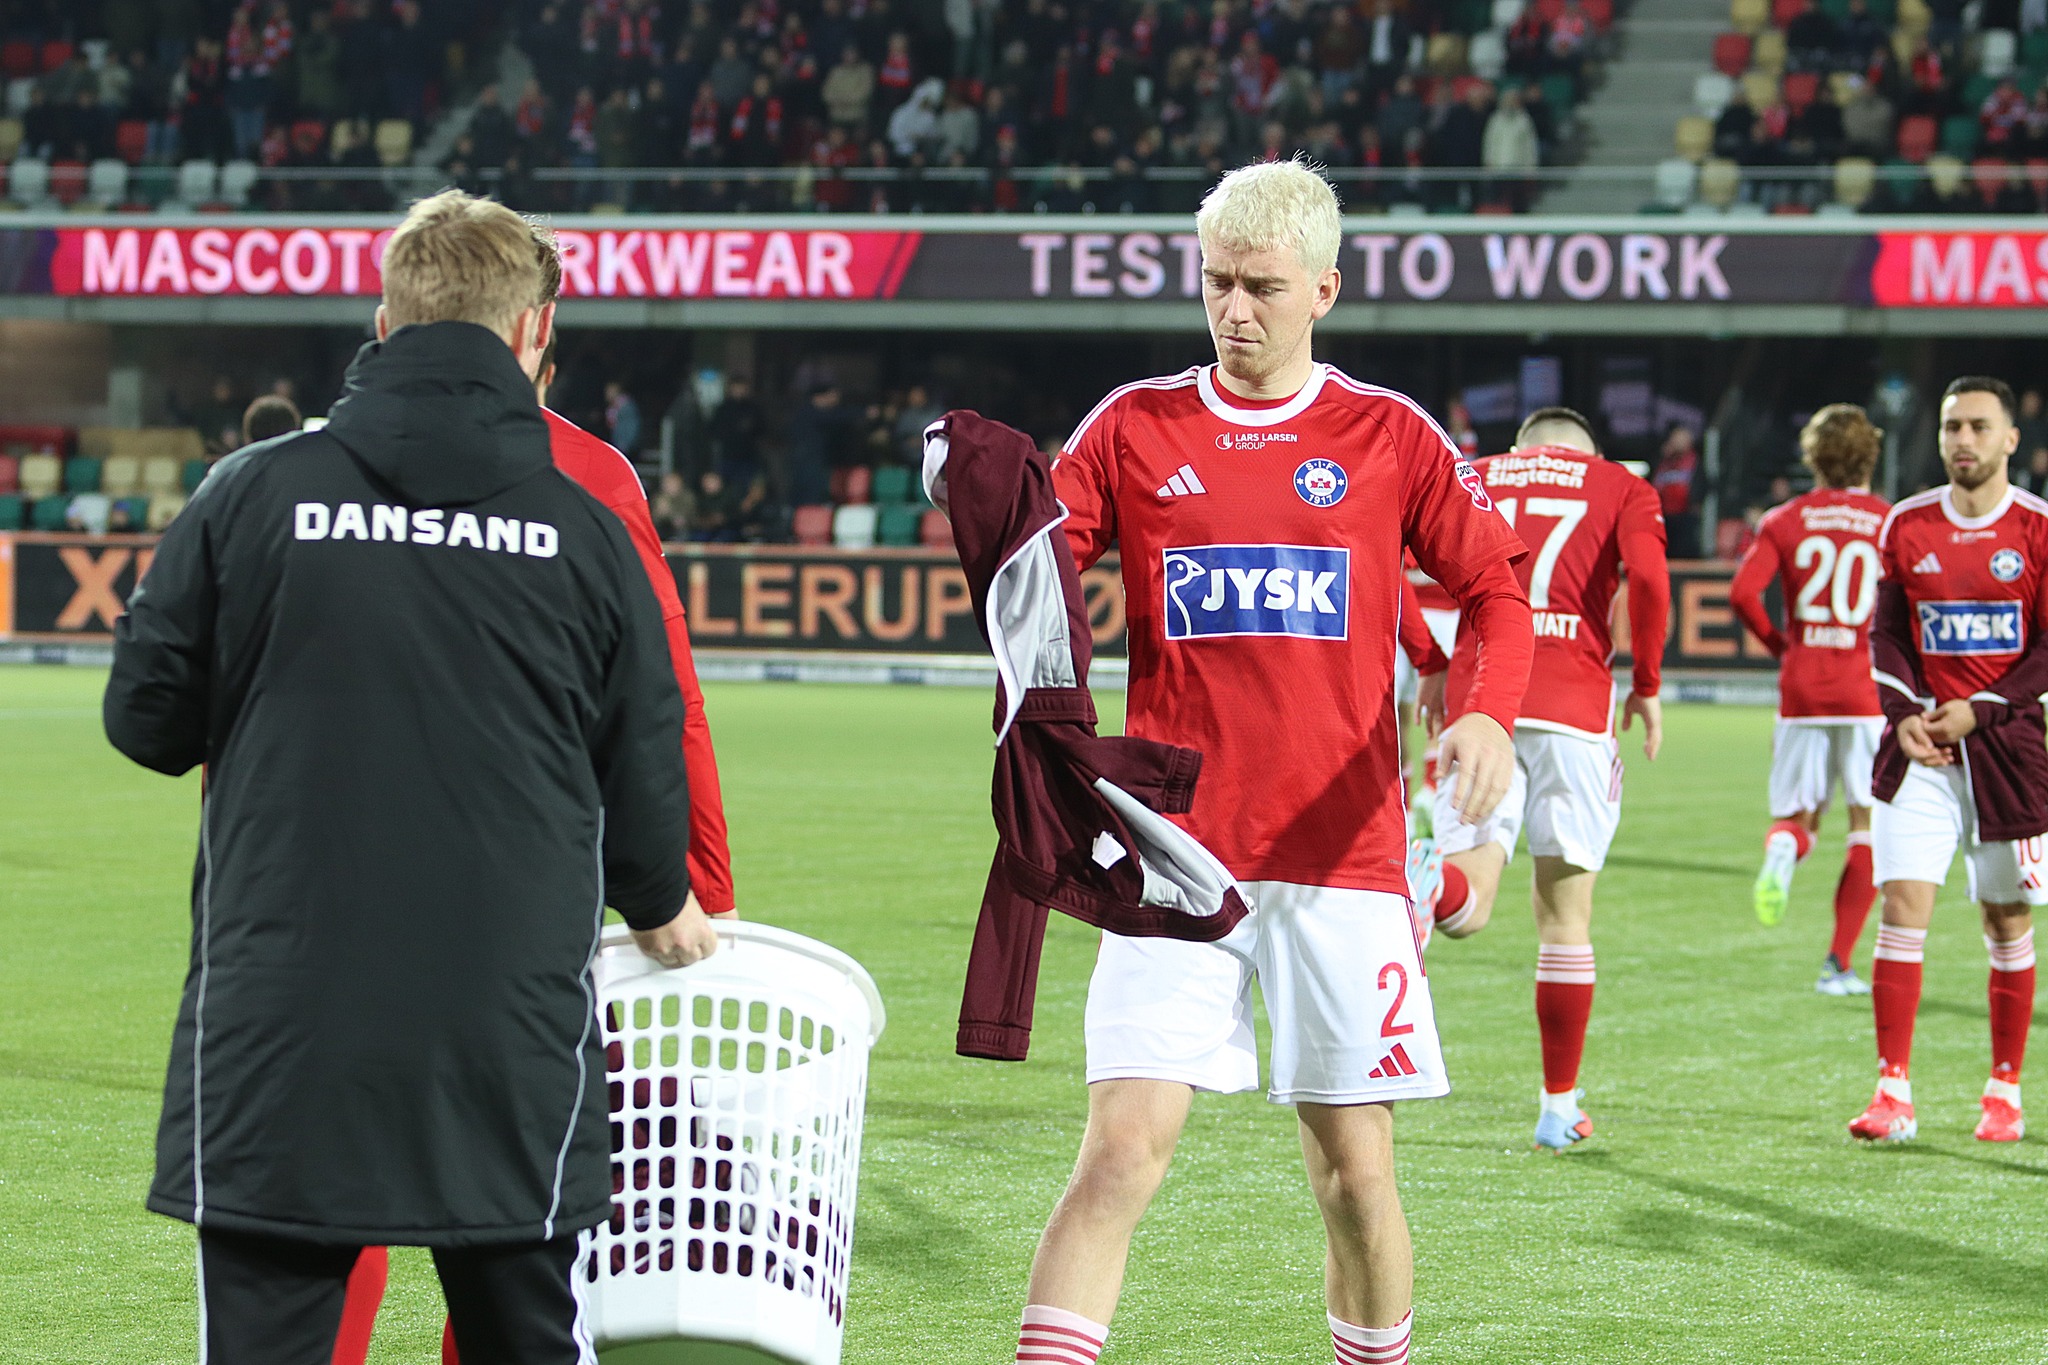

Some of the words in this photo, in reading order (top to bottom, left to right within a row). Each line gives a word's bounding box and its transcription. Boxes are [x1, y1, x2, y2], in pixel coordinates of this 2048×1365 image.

[83, 229, 372, 294] MASCOT
[556, 231, 854, 297] RKWEAR
[1018, 232, 1202, 298] TEST
[1352, 233, 1455, 299] TO
[1483, 233, 1732, 299] WORK
[1910, 235, 2048, 303] MA
[1235, 433, 1260, 442] LARS
[1262, 433, 1298, 443] LARSEN
[1235, 441, 1266, 450] GROUP
[1485, 470, 1585, 490] Slagteren
[1488, 454, 1589, 478] Silkeborg
[1308, 494, 1334, 506] 1917
[294, 502, 560, 558] DANSAND
[688, 561, 975, 642] LERUP
[1200, 567, 1338, 615] JYSK
[1795, 535, 1879, 627] 20
[1534, 612, 1582, 641] WATT
[1938, 612, 2016, 642] JYSK
[1377, 961, 1415, 1039] 2
